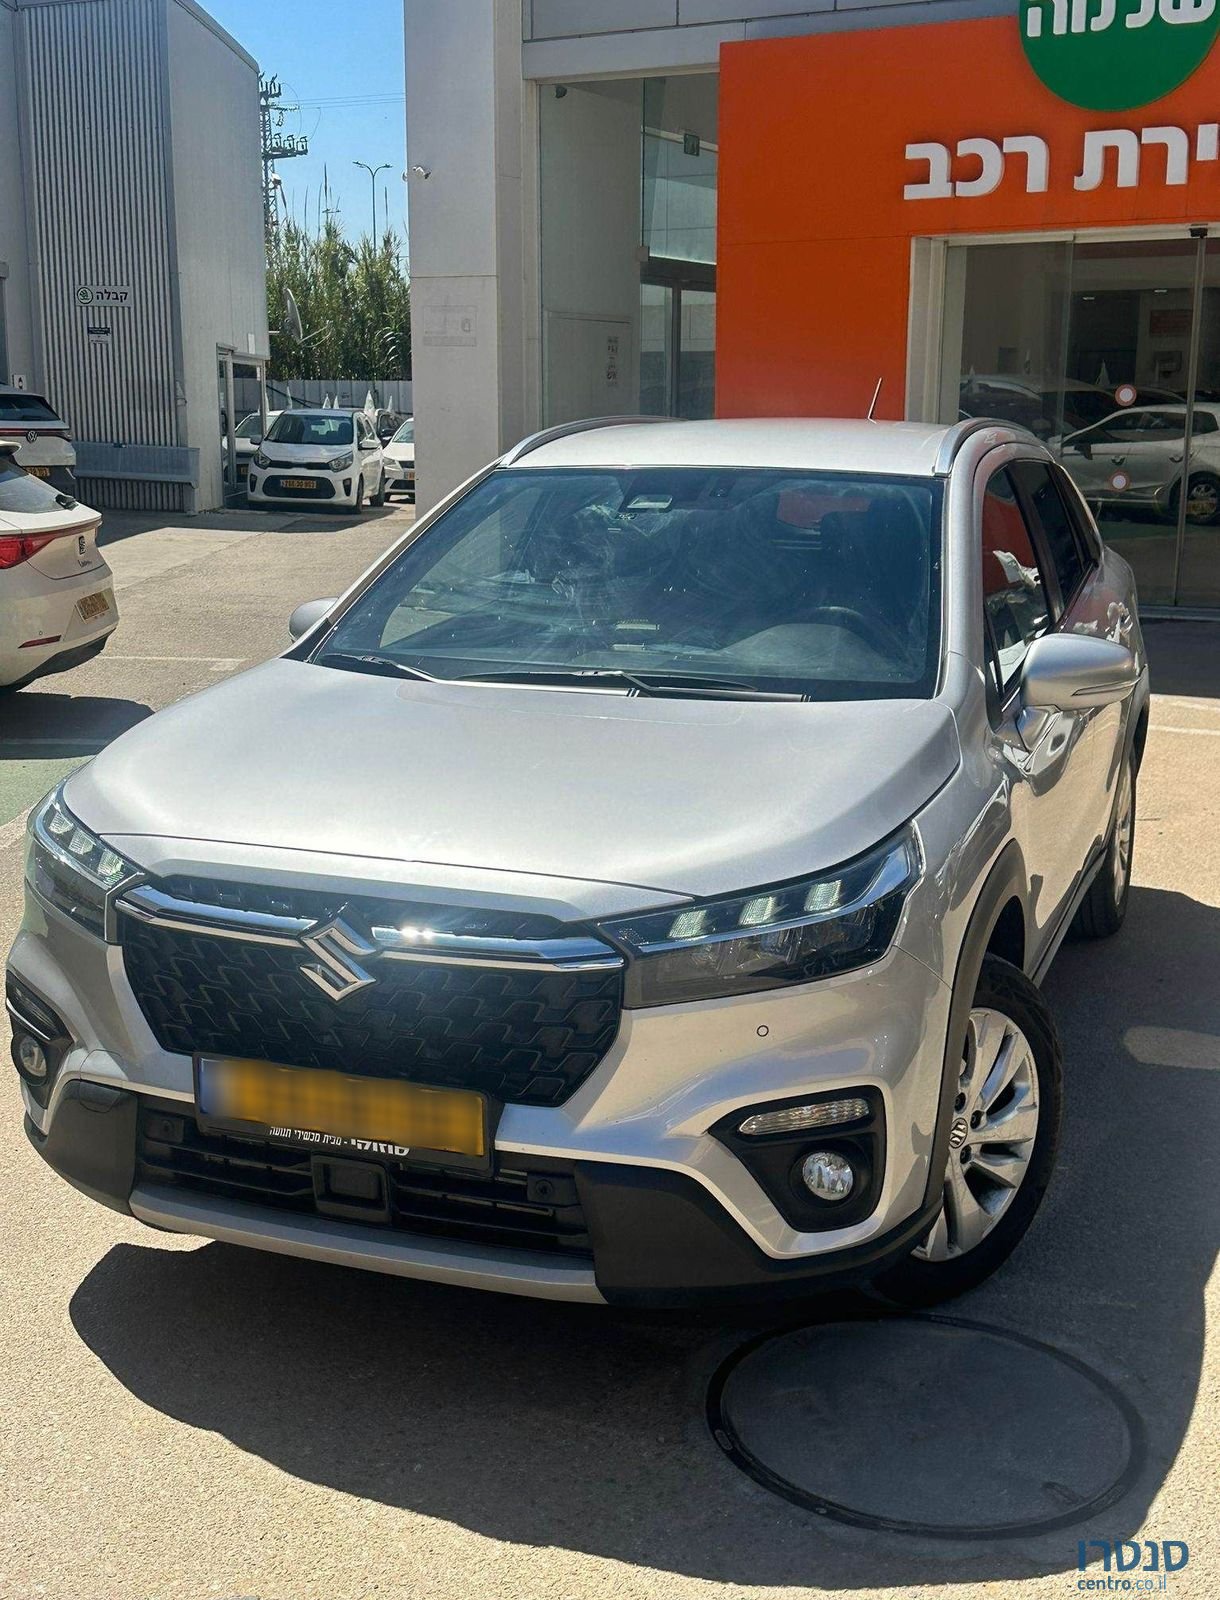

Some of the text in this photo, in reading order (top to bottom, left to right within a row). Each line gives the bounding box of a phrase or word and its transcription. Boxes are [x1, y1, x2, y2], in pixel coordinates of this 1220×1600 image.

[903, 135, 1049, 200] רכב
[95, 288, 129, 303] קבלה
[269, 1126, 292, 1139] תנועה
[295, 1129, 321, 1143] מכשירי
